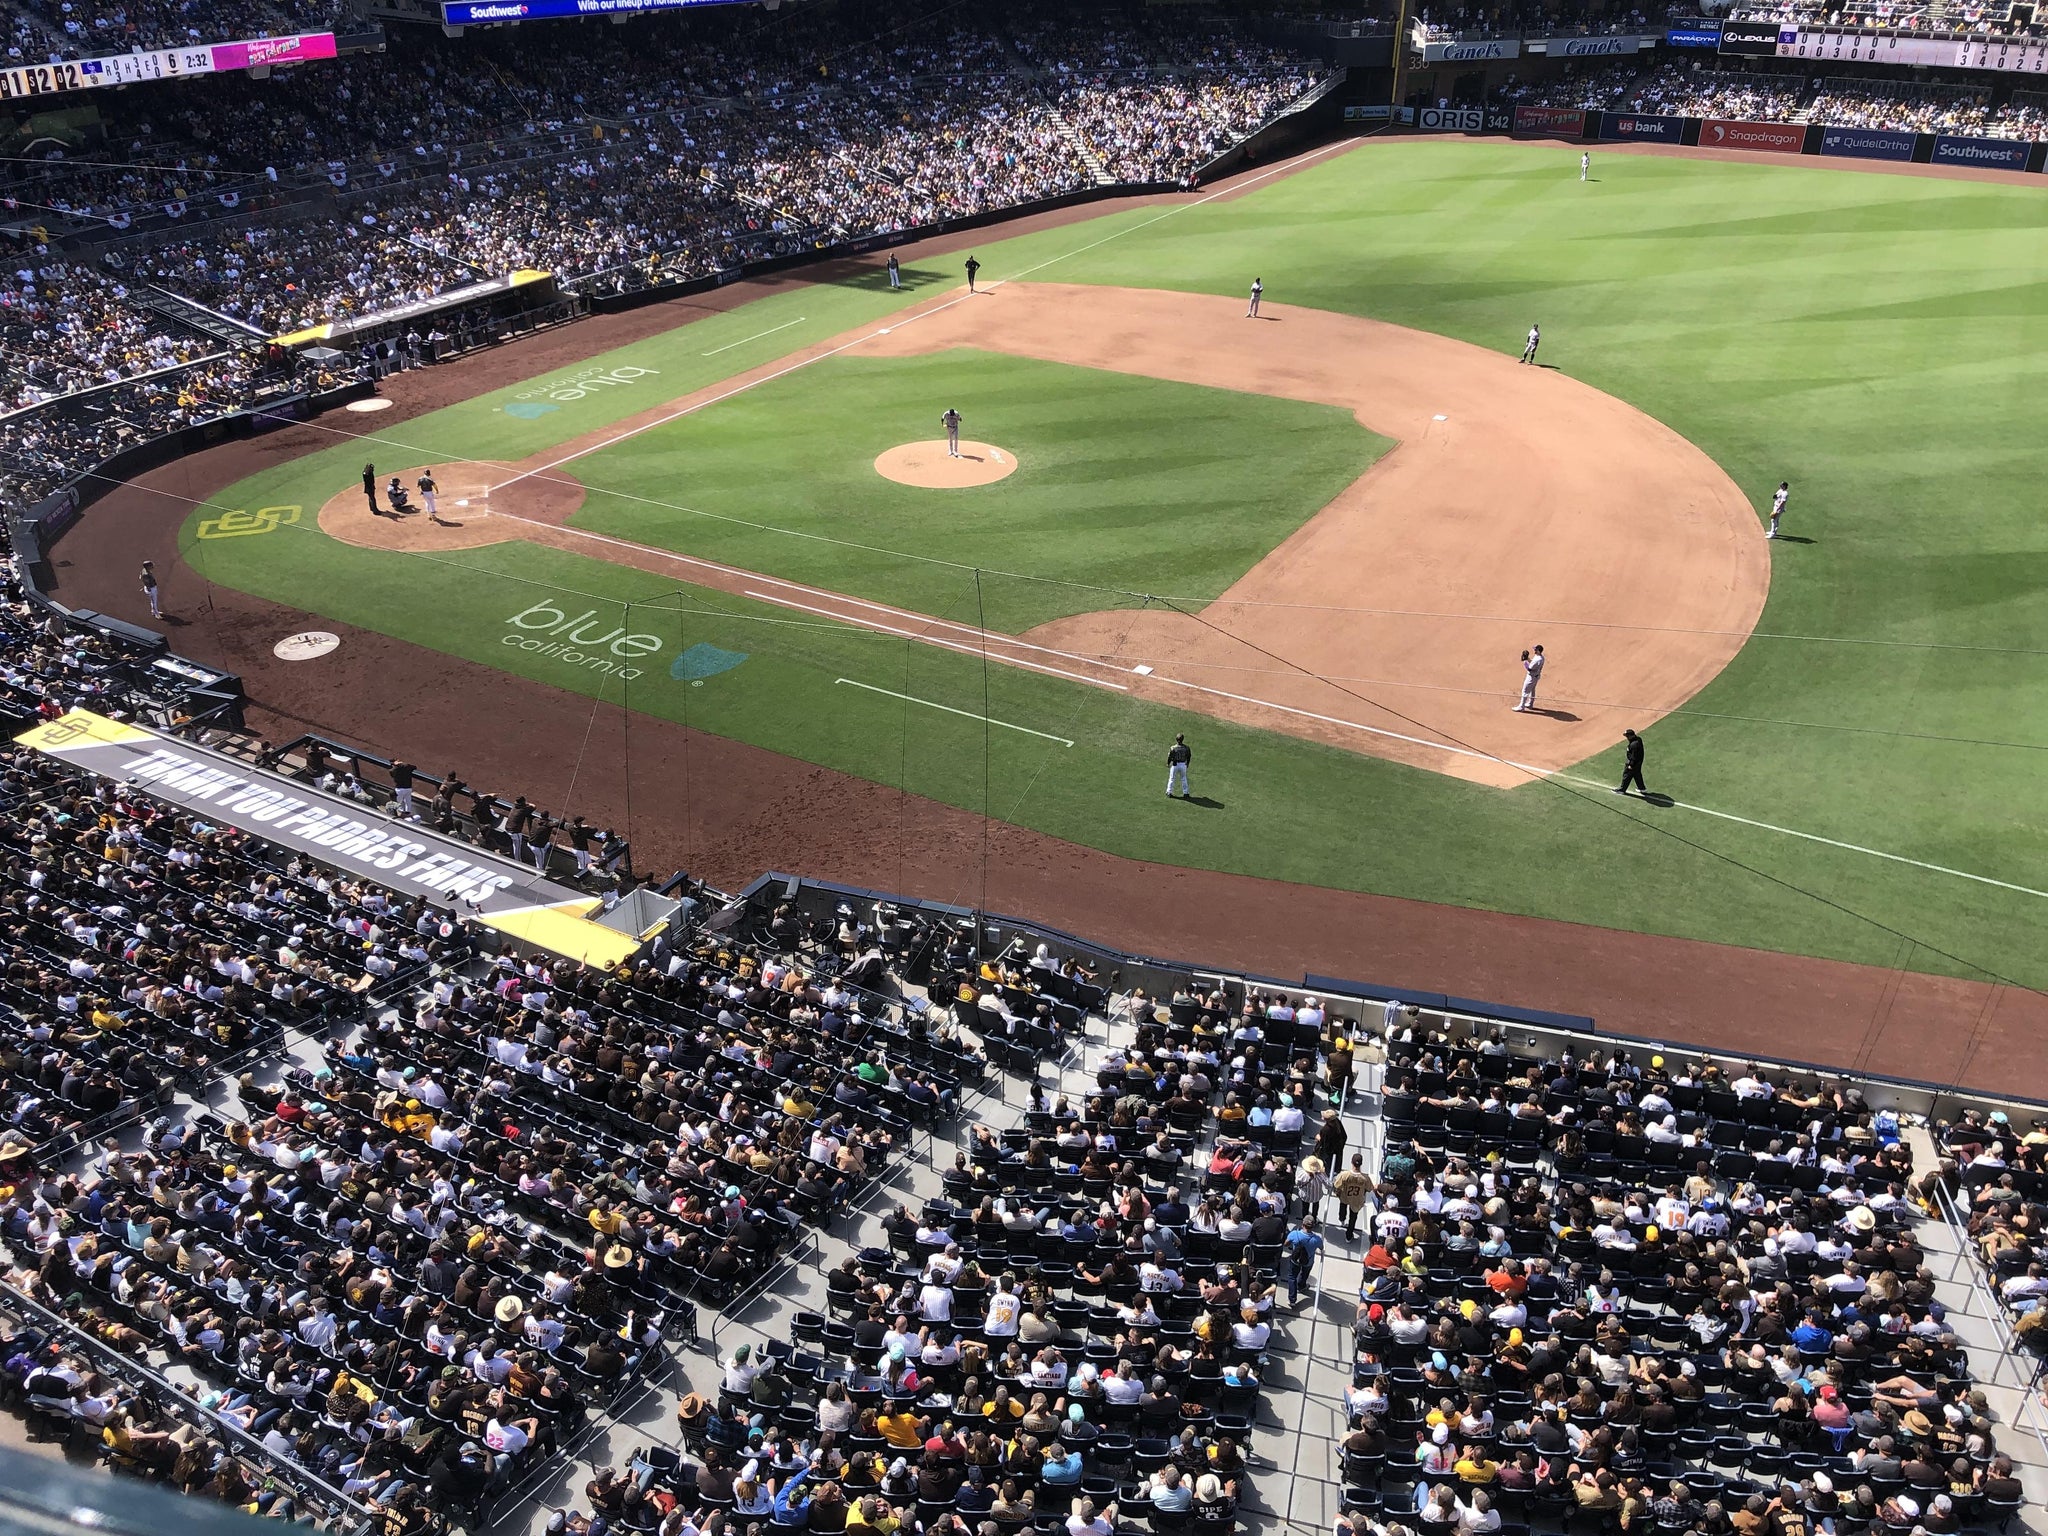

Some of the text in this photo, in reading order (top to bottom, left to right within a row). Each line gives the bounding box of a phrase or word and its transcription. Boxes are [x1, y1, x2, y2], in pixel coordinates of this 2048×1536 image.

[470, 5, 521, 18] Southwest
[577, 0, 600, 12] With
[600, 1, 615, 10] our
[616, 0, 641, 9] lineup
[1443, 42, 1502, 59] Canel's
[1564, 38, 1624, 54] Canel's
[1802, 34, 1808, 44] 0
[1820, 35, 1825, 44] 0
[1837, 36, 1843, 45] 0
[1854, 36, 1860, 46] 0
[1872, 37, 1878, 47] 0
[1890, 38, 1896, 48] 0
[1964, 42, 1970, 53] 0
[1982, 44, 1989, 54] 3
[2001, 44, 2008, 55] 0
[2020, 46, 2026, 56] 3
[2038, 48, 2045, 58] 4
[124, 57, 139, 74] H 3
[144, 54, 158, 71] E 0
[168, 54, 176, 68] 6
[186, 54, 208, 68] 2:32
[1799, 46, 1805, 55] 0
[1816, 47, 1822, 56] 0
[1833, 48, 1839, 57] 3
[1851, 48, 1857, 58] 0
[1869, 49, 1875, 59] 0
[1960, 55, 1966, 65] 3
[1979, 56, 1985, 66] 4
[1998, 57, 2004, 68] 0
[2017, 59, 2023, 69] 2
[2035, 60, 2042, 70] 5
[106, 60, 119, 76] R 0
[136, 68, 142, 80] 4
[154, 66, 160, 78] 0
[2, 80, 8, 91] B
[11, 72, 22, 94] 1
[29, 76, 36, 87] S
[38, 68, 52, 91] 2
[66, 64, 78, 87] 2
[116, 72, 121, 82] 3
[1422, 110, 1480, 129] ORIS
[1488, 116, 1508, 128] 342
[1619, 120, 1664, 133] us bank
[1730, 130, 1797, 145] Snapdragon
[1844, 138, 1910, 151] QuidelOrtho
[1938, 144, 2013, 160] Southwest
[514, 367, 604, 400] california
[550, 366, 660, 400] blue
[504, 598, 663, 657] blue
[502, 634, 644, 680] california
[120, 749, 514, 903] THANK YOU PADRES FANS
[1347, 1185, 1360, 1196] 23
[1668, 1211, 1685, 1227] 19
[1386, 1226, 1400, 1237] 19
[1146, 1272, 1170, 1282] MACHADO
[1150, 1281, 1162, 1292] 13
[996, 1308, 1012, 1323] 19
